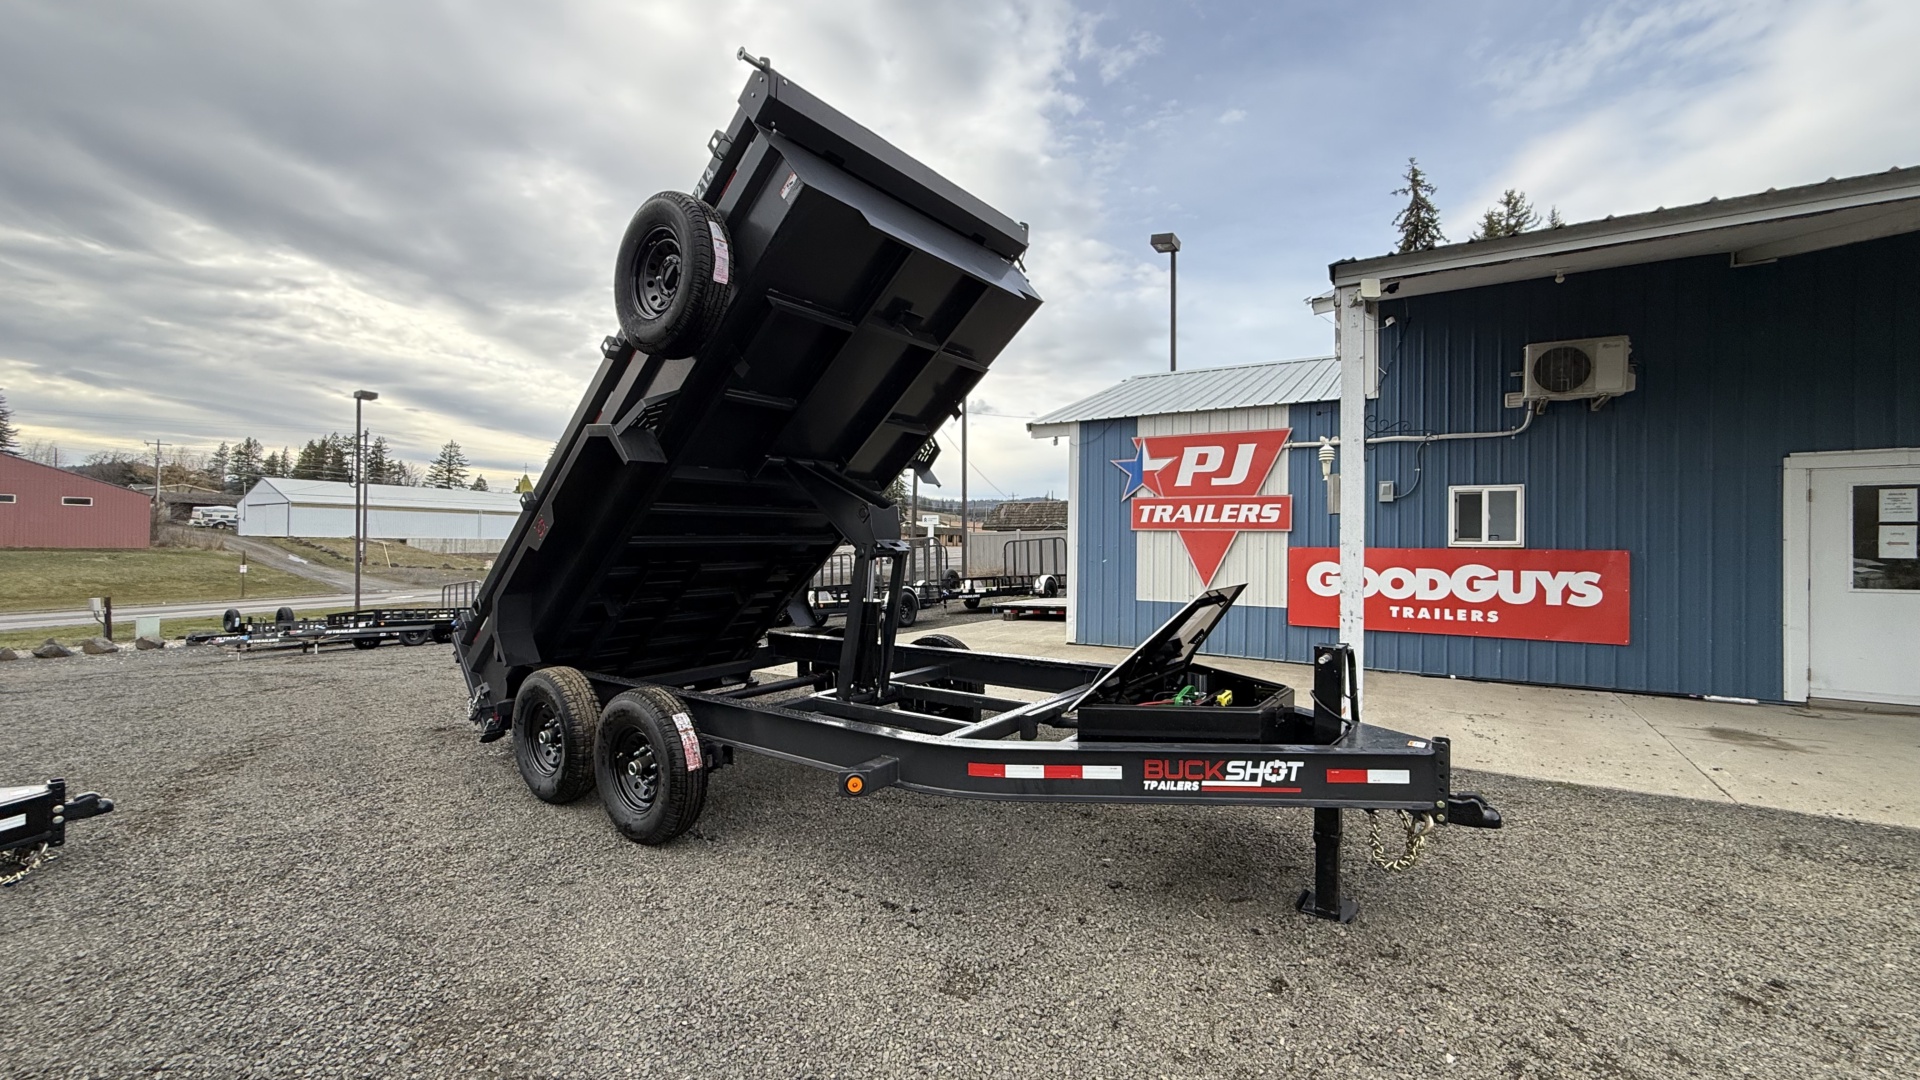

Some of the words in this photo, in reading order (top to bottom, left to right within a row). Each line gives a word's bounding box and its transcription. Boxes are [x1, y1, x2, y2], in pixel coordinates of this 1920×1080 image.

[692, 166, 714, 200] 214
[1174, 443, 1258, 487] PJ
[1138, 503, 1282, 523] TRAILERS
[1389, 605, 1499, 623] TRAILERS
[1144, 759, 1305, 784] BUCKSHOT
